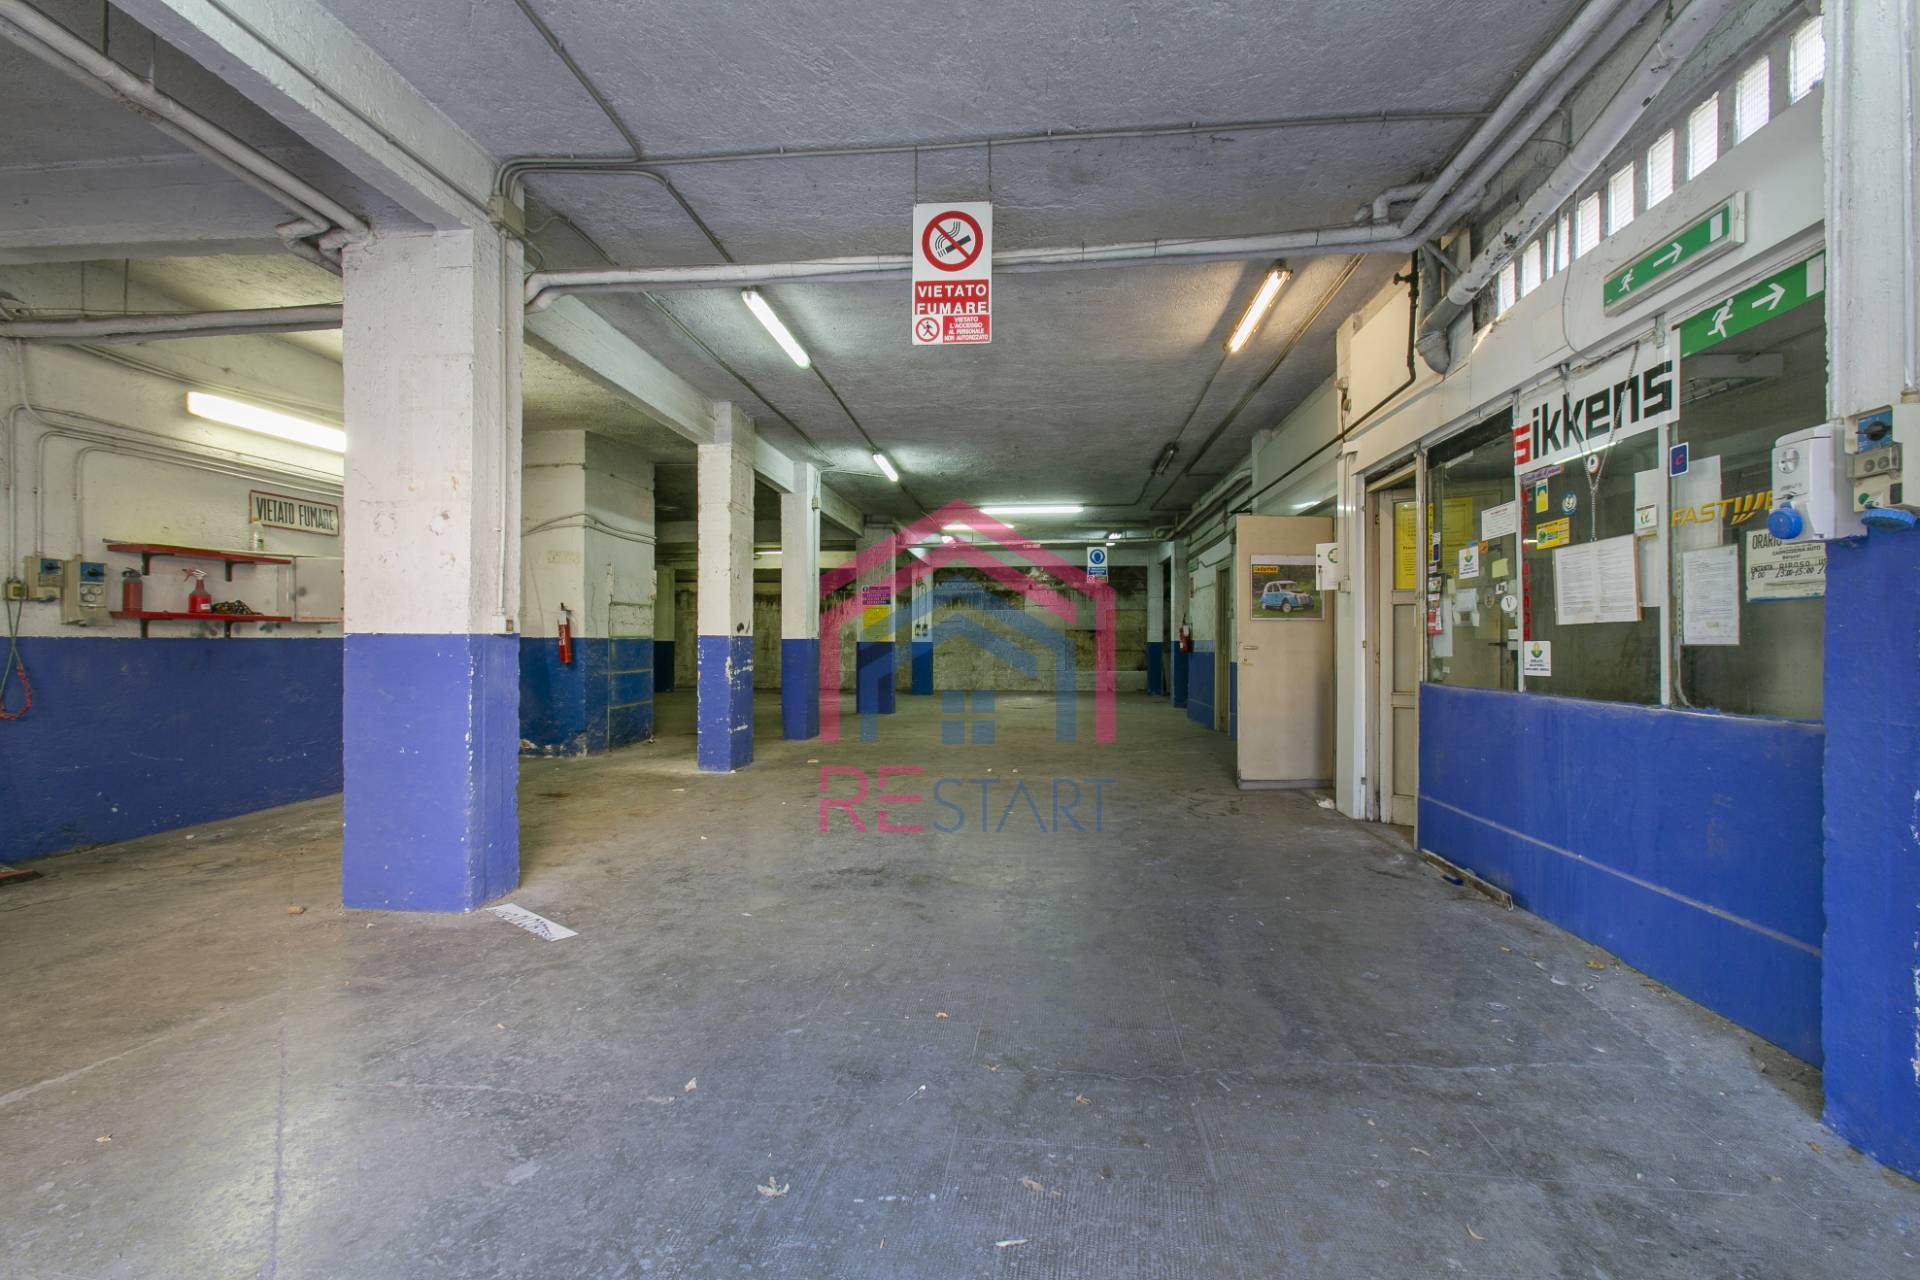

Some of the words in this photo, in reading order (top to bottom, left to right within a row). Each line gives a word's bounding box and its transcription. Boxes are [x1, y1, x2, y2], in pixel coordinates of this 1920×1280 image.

[917, 284, 987, 298] VIETATO
[916, 301, 988, 315] FUMARE
[256, 497, 295, 525] VIETATO
[299, 505, 334, 531] FUMARE
